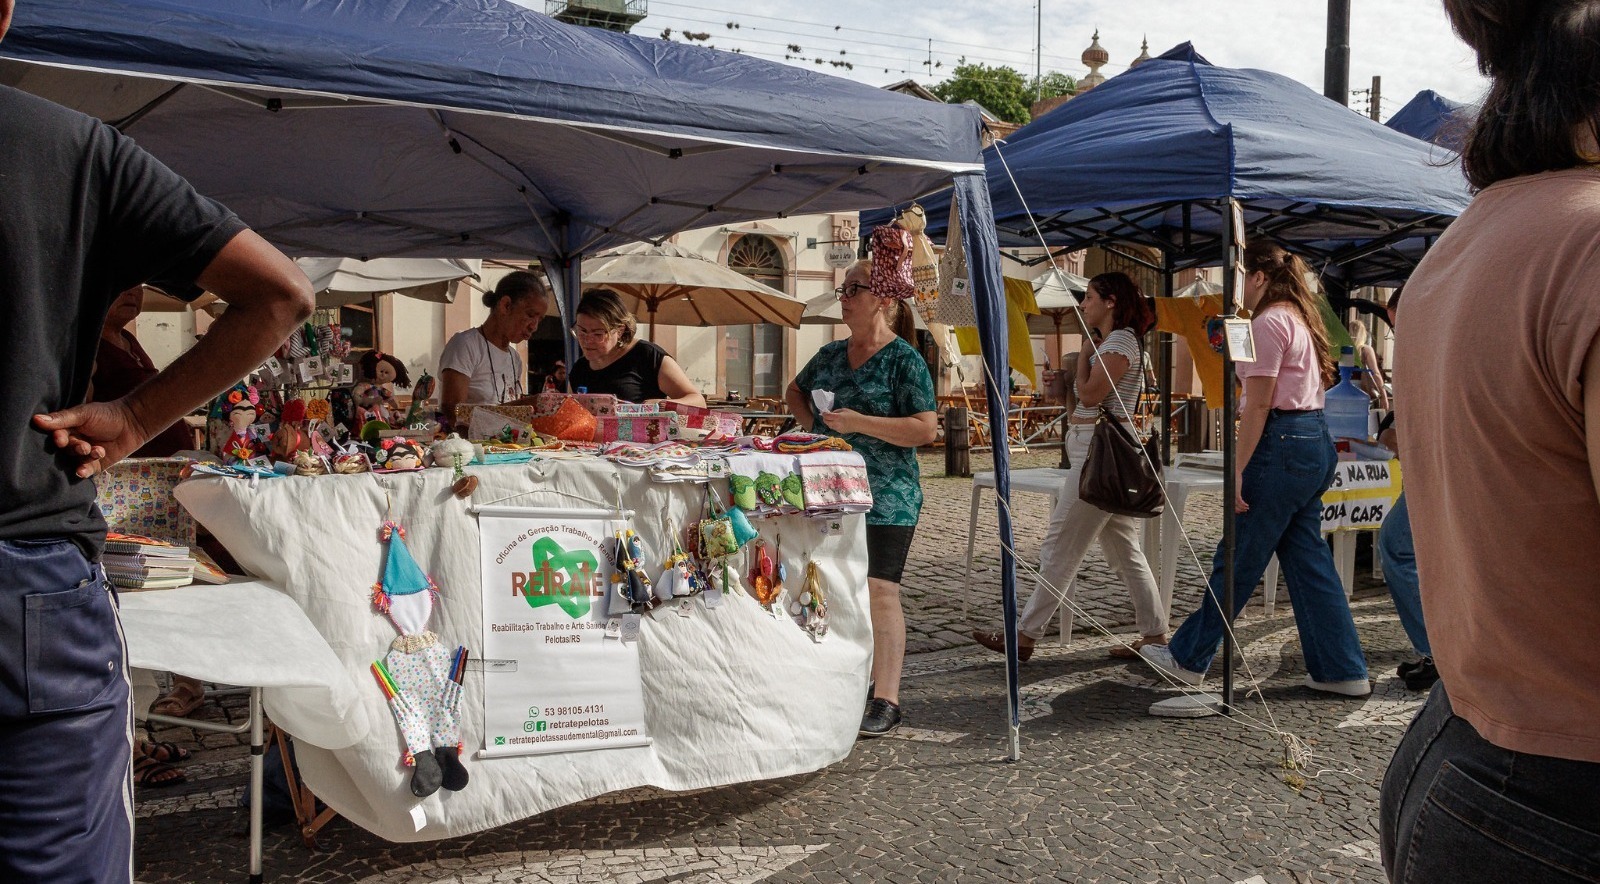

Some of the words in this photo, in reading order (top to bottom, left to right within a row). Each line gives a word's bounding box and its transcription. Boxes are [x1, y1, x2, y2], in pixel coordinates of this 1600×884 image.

[1347, 464, 1365, 482] NA
[1365, 464, 1389, 481] RUA
[1350, 505, 1383, 523] CAPS
[496, 541, 518, 565] Oficina
[518, 533, 527, 543] de
[527, 525, 559, 537] Geração
[561, 525, 593, 542] Trabalho
[598, 543, 615, 567] Renda
[511, 562, 605, 597] RETRATE
[491, 623, 535, 633] Reabilitação
[536, 622, 565, 631] Trabalho
[571, 622, 585, 630] Arte
[545, 635, 581, 644] Pelotas/RS
[544, 707, 555, 716] 53
[557, 705, 604, 716] 98105.4131
[549, 718, 609, 729] retratepelotas
[509, 728, 638, 744] retratepelotassaudemental@gmail.com
